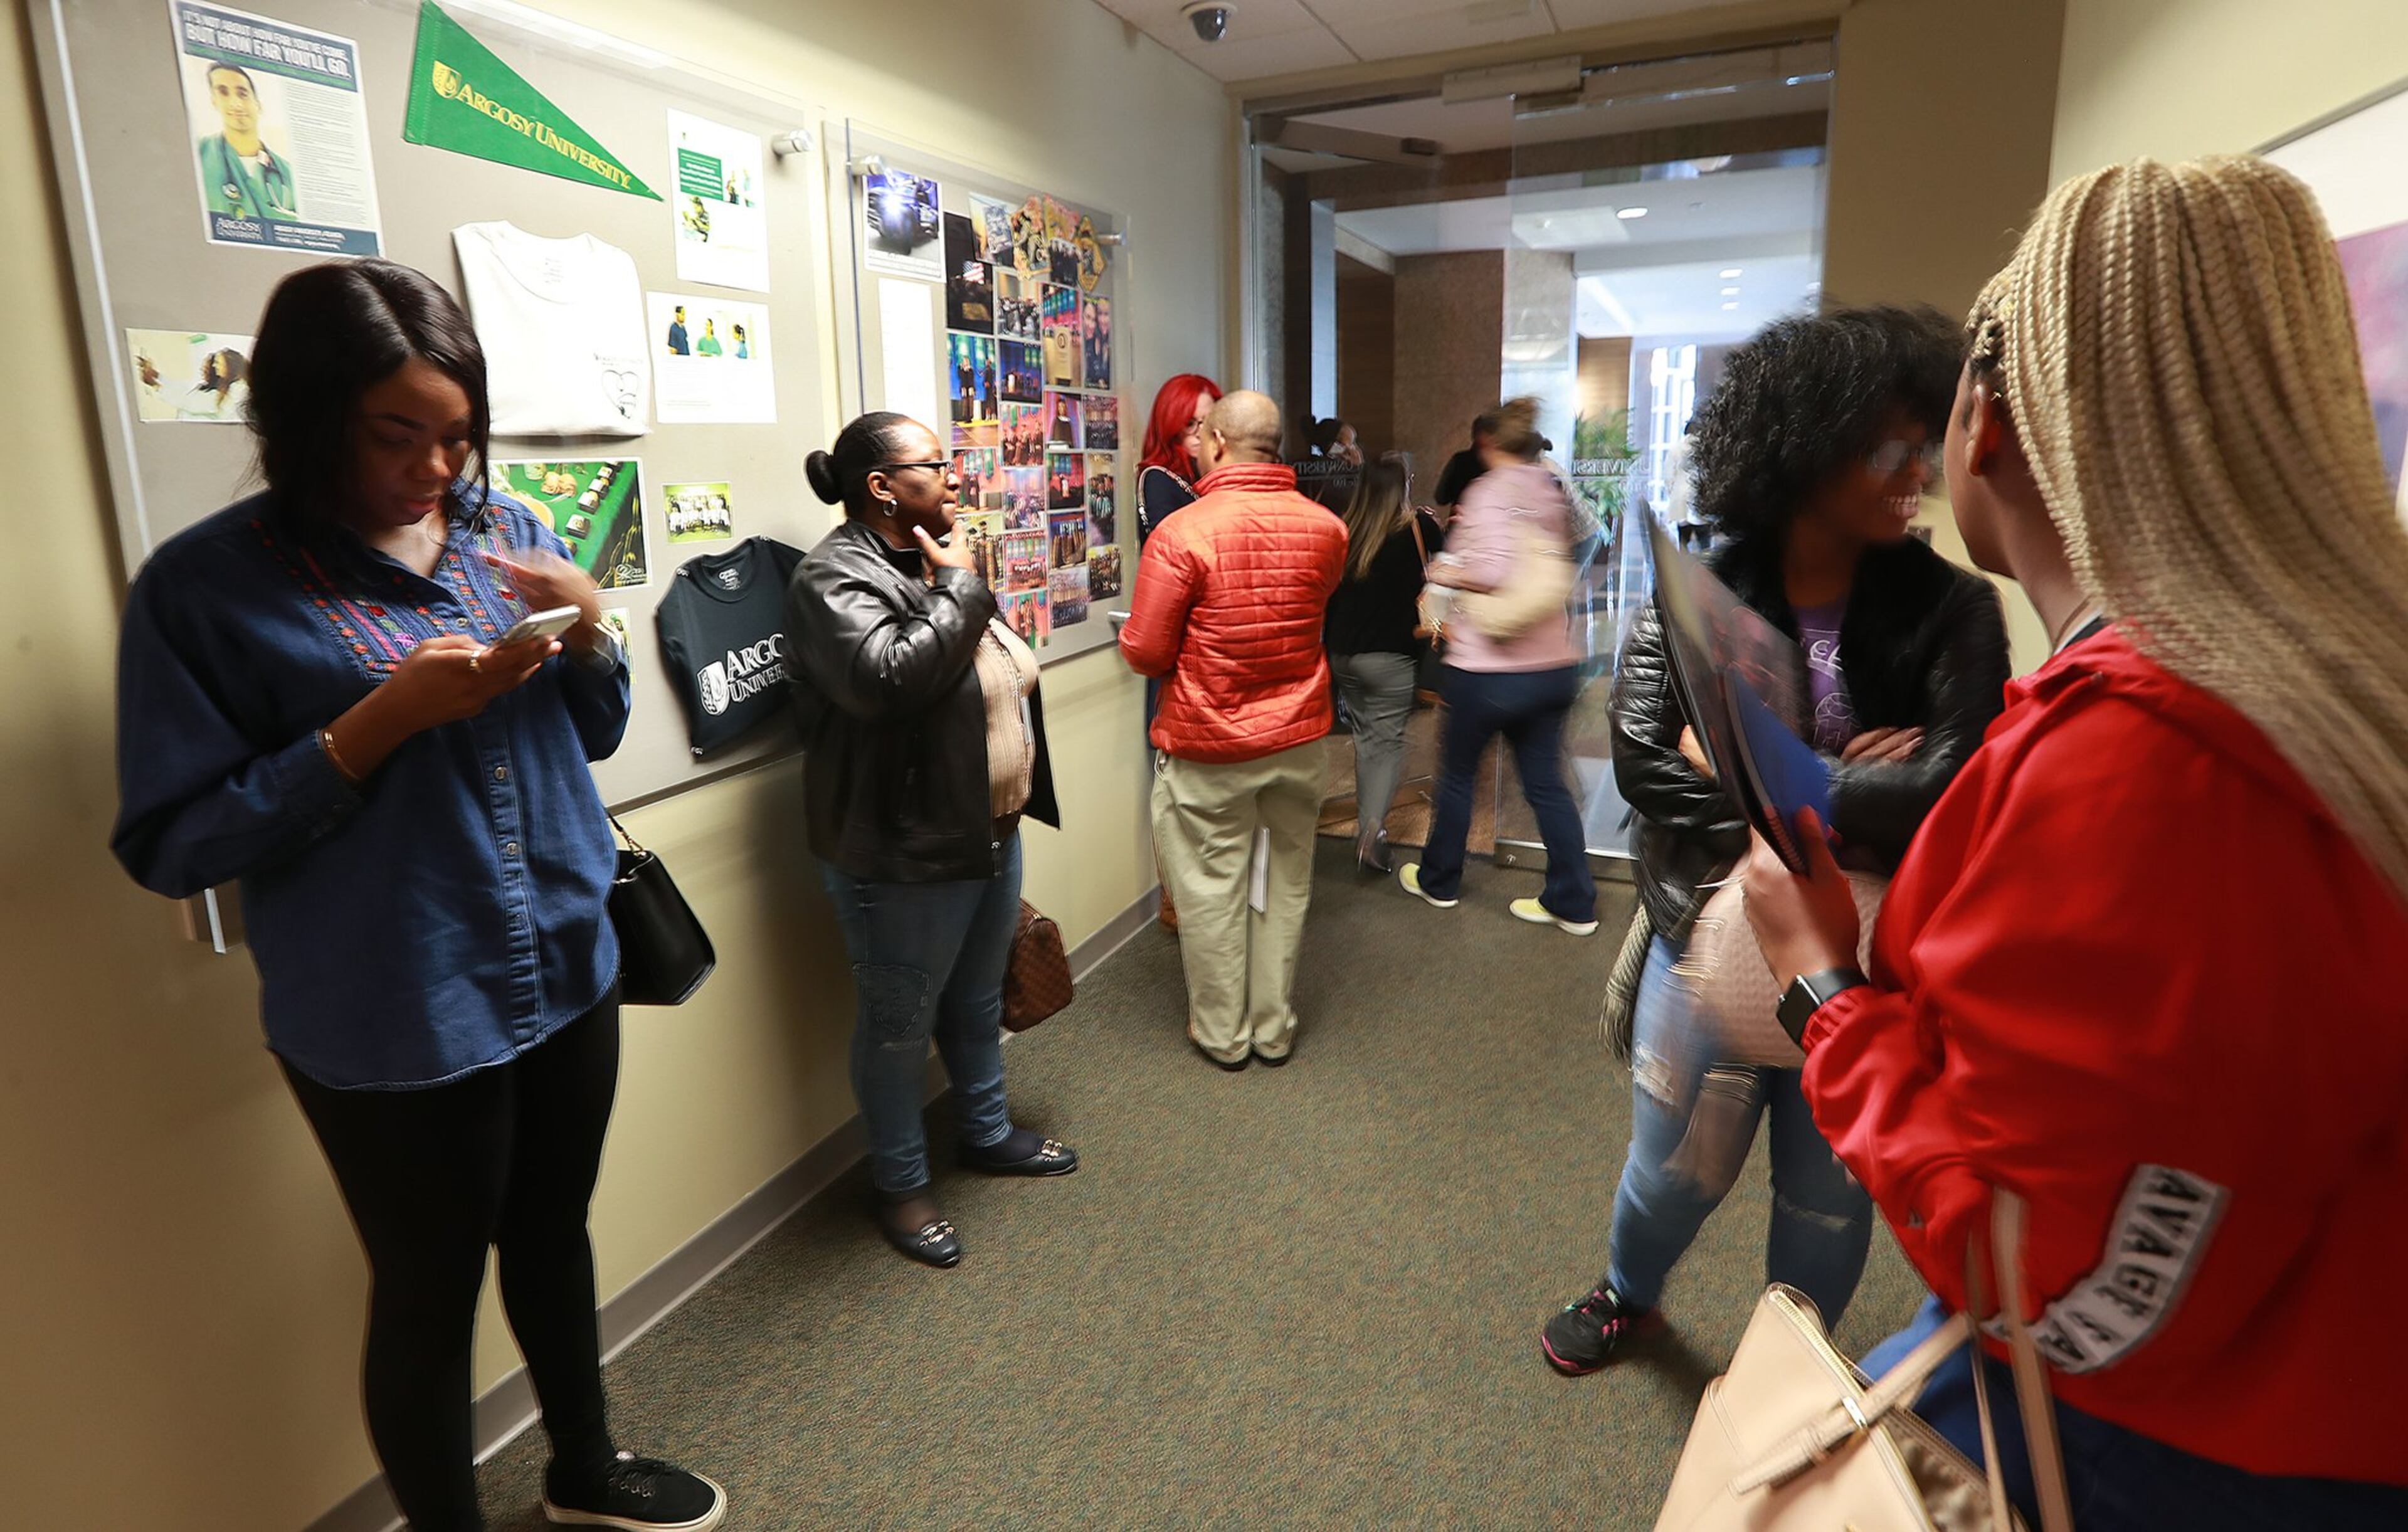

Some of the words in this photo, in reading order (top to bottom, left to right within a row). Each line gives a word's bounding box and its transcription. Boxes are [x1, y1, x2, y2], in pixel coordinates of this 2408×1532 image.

[217, 30, 252, 55] HOW
[253, 38, 283, 61] FAR
[457, 83, 536, 137] ARGOSY
[534, 121, 632, 189] UNIVERSITY
